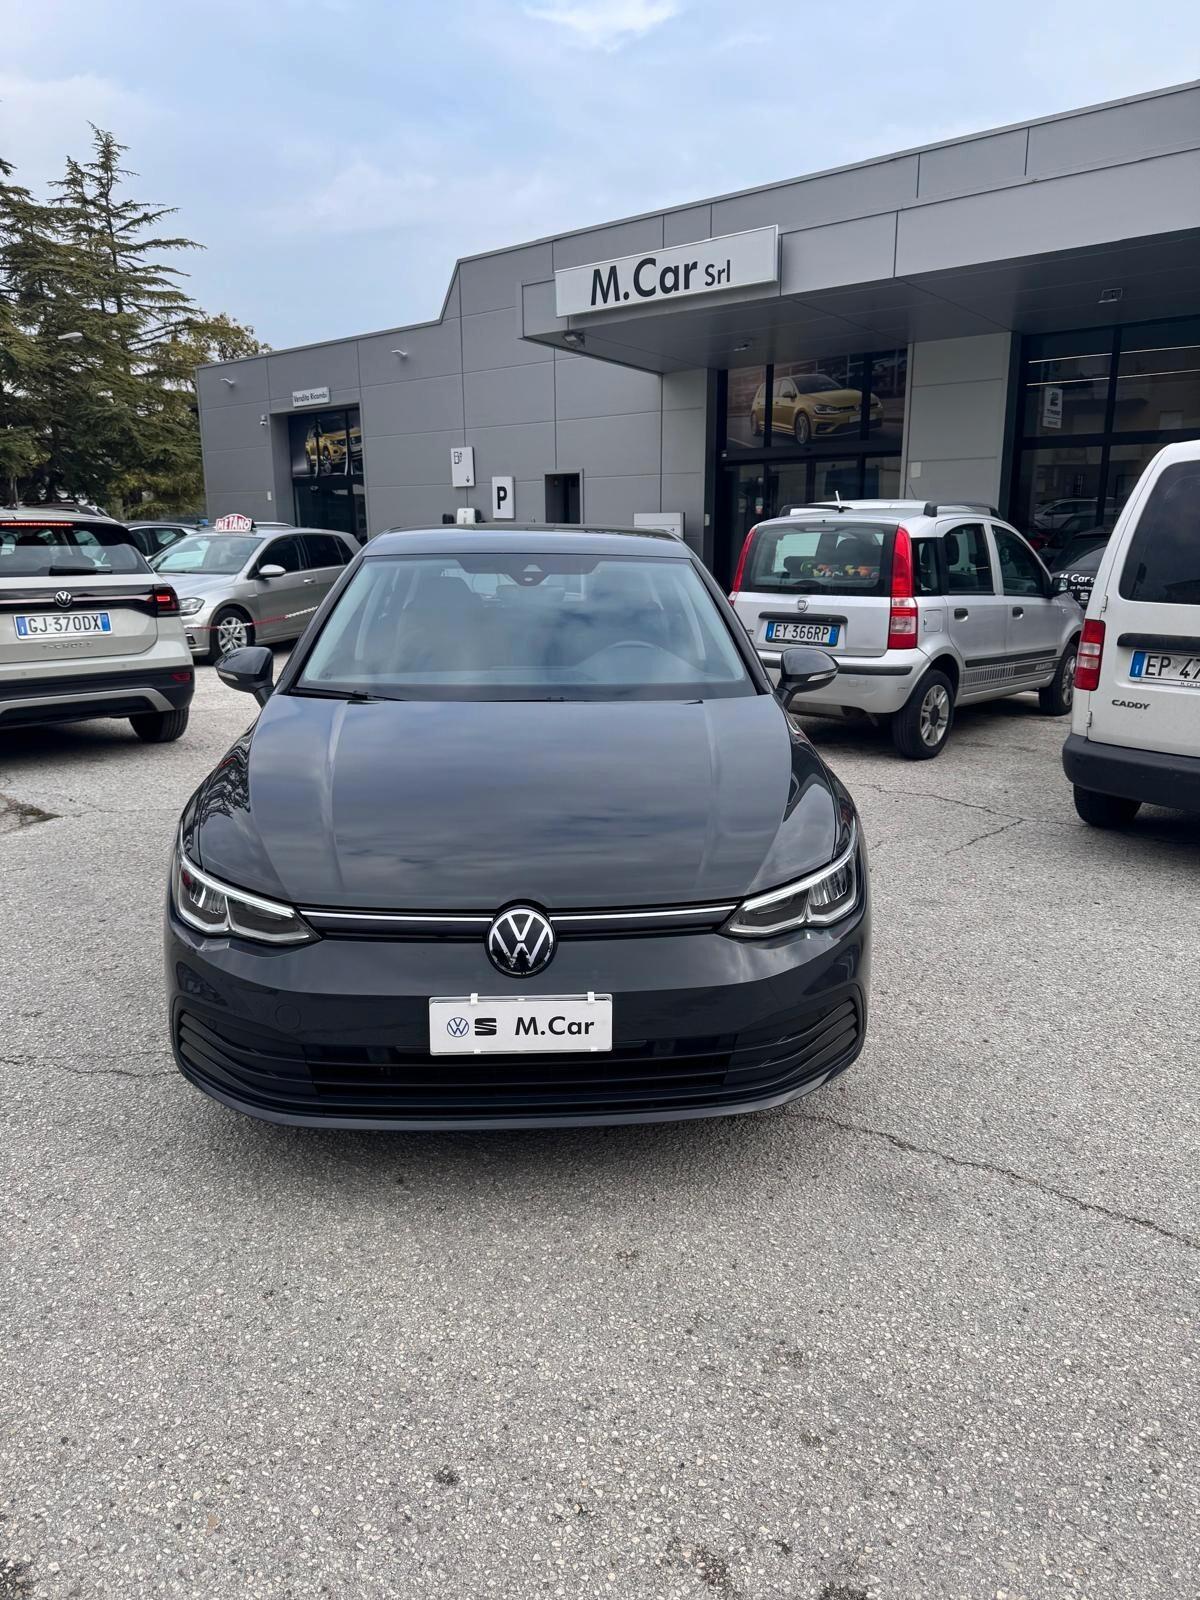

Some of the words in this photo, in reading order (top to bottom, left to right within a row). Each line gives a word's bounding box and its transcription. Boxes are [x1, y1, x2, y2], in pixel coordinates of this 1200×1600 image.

[590, 257, 698, 306] M.Car
[704, 259, 731, 287] Srl
[496, 486, 508, 510] P
[218, 516, 250, 530] METANO
[28, 617, 48, 633] GJ
[53, 615, 101, 632] 370DX
[774, 624, 790, 638] EY
[791, 625, 830, 641] 366RP
[1144, 655, 1172, 677] EP
[1111, 699, 1151, 711] CADDY
[514, 1015, 595, 1037] M.Car
